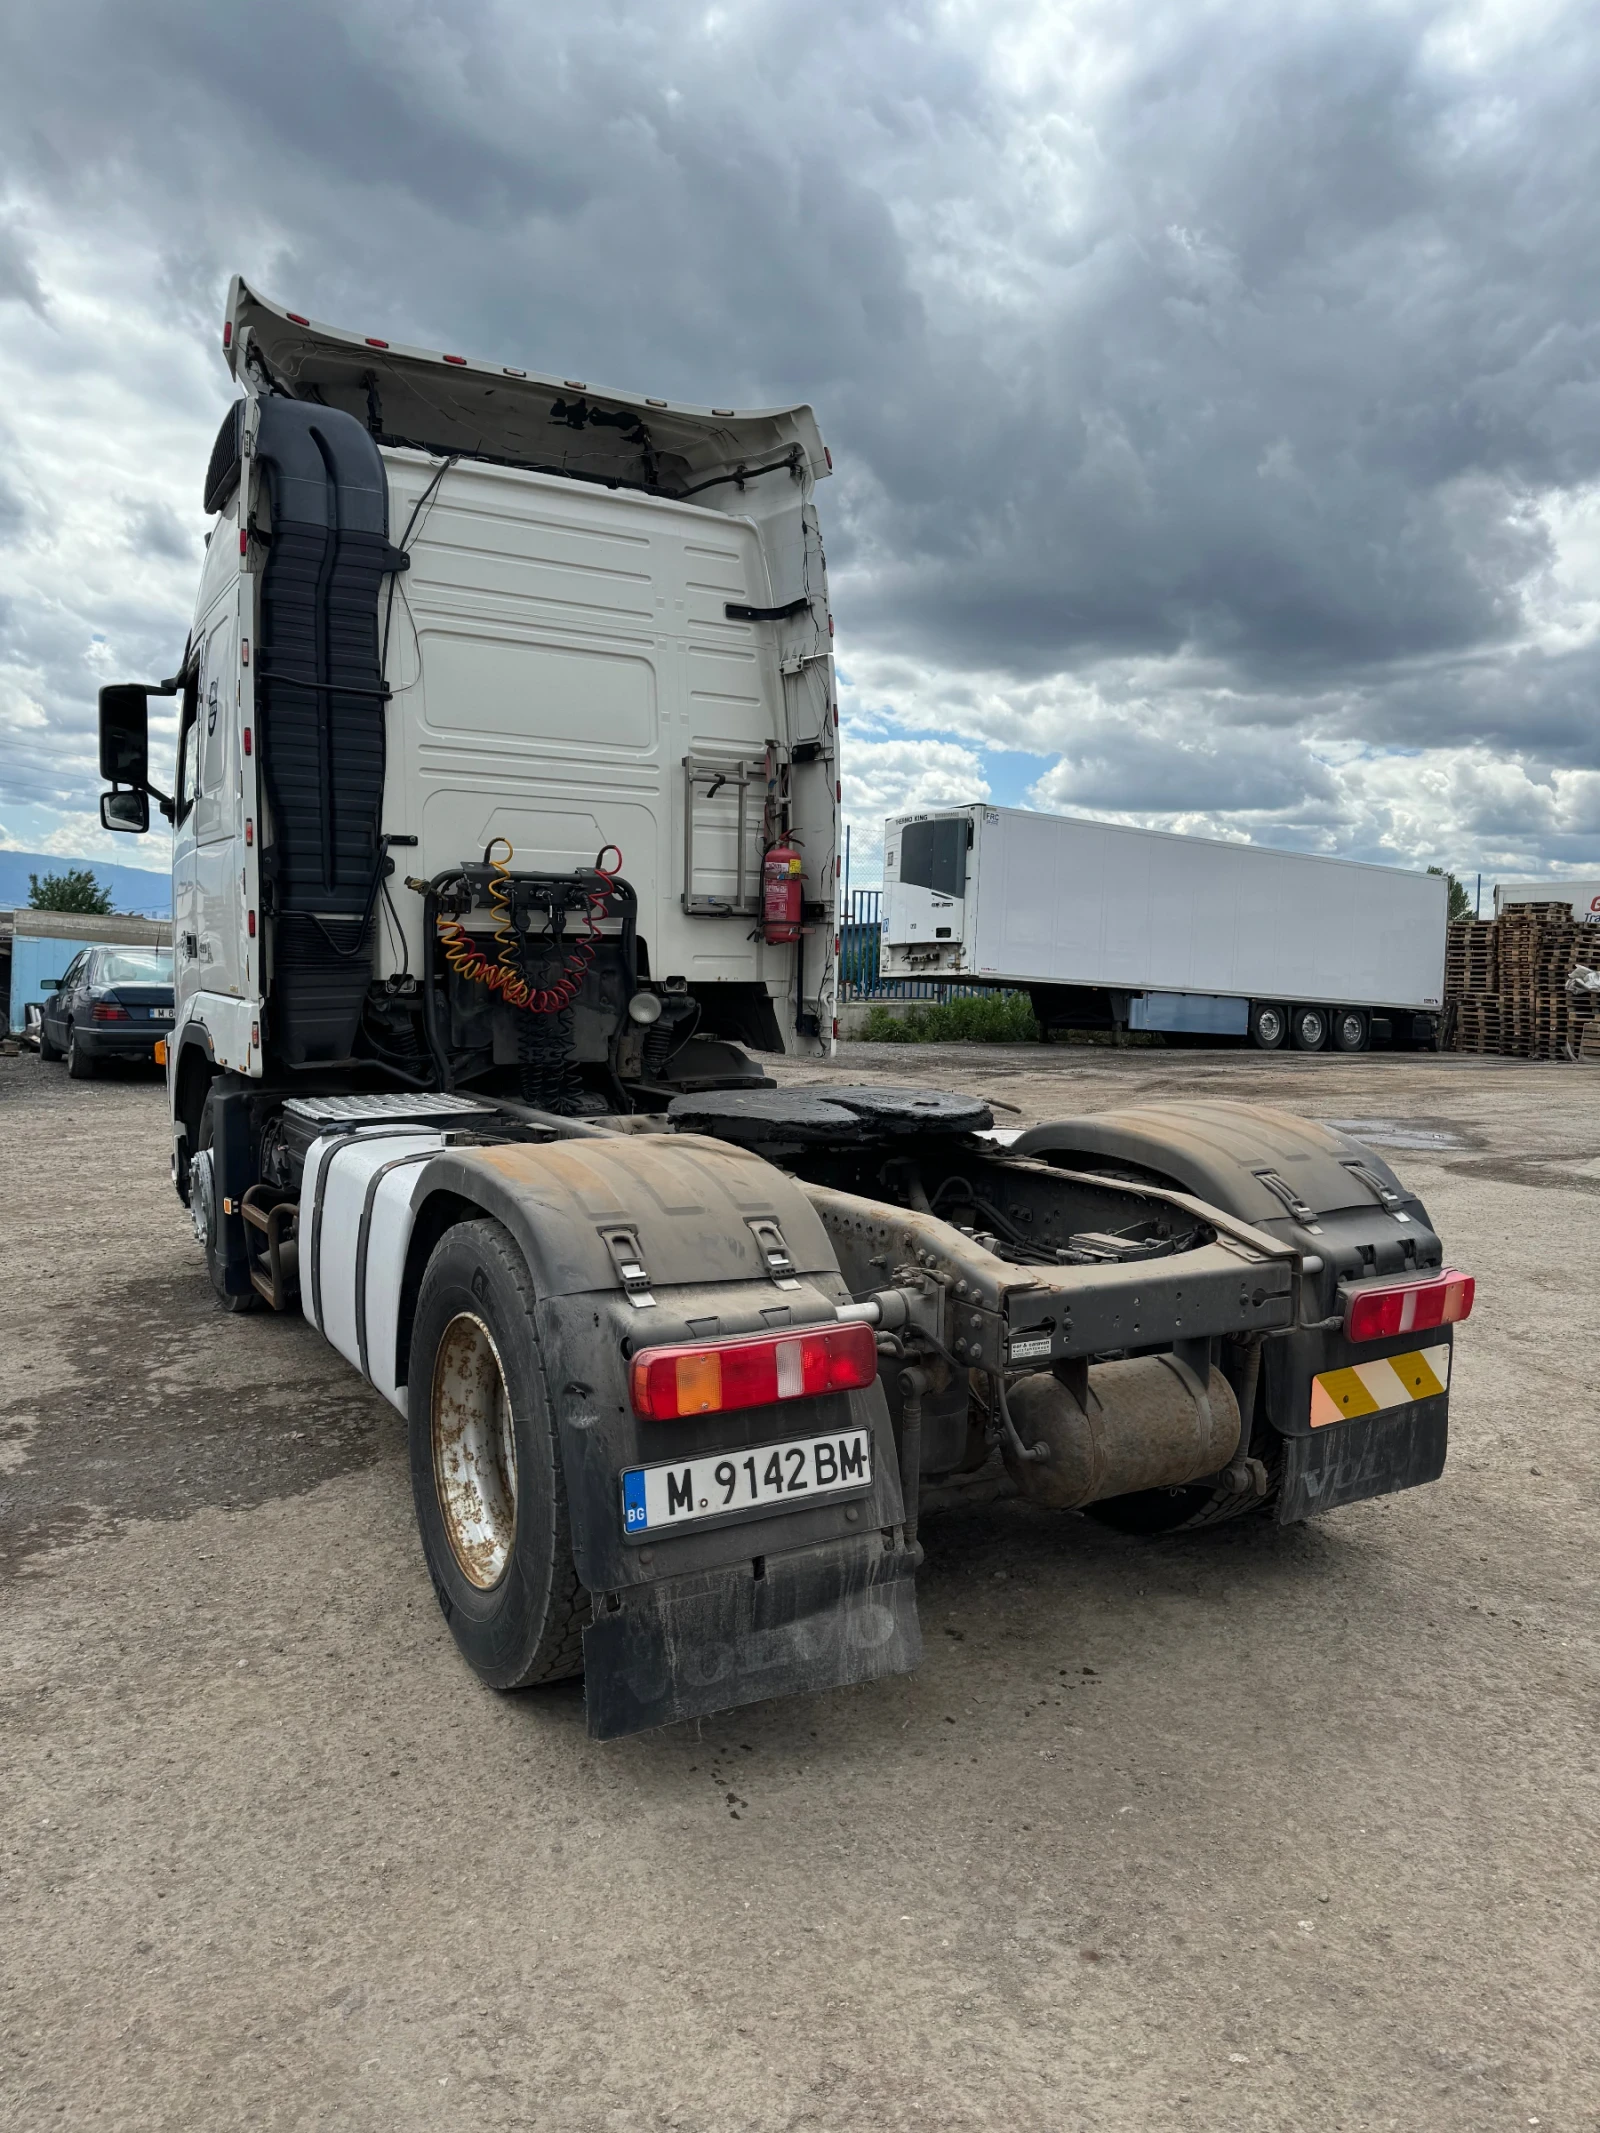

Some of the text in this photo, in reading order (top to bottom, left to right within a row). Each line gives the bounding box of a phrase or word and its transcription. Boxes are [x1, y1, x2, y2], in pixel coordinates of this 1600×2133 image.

[986, 812, 1000, 821] FRC
[666, 1468, 694, 1516] M
[627, 1507, 645, 1524] BG
